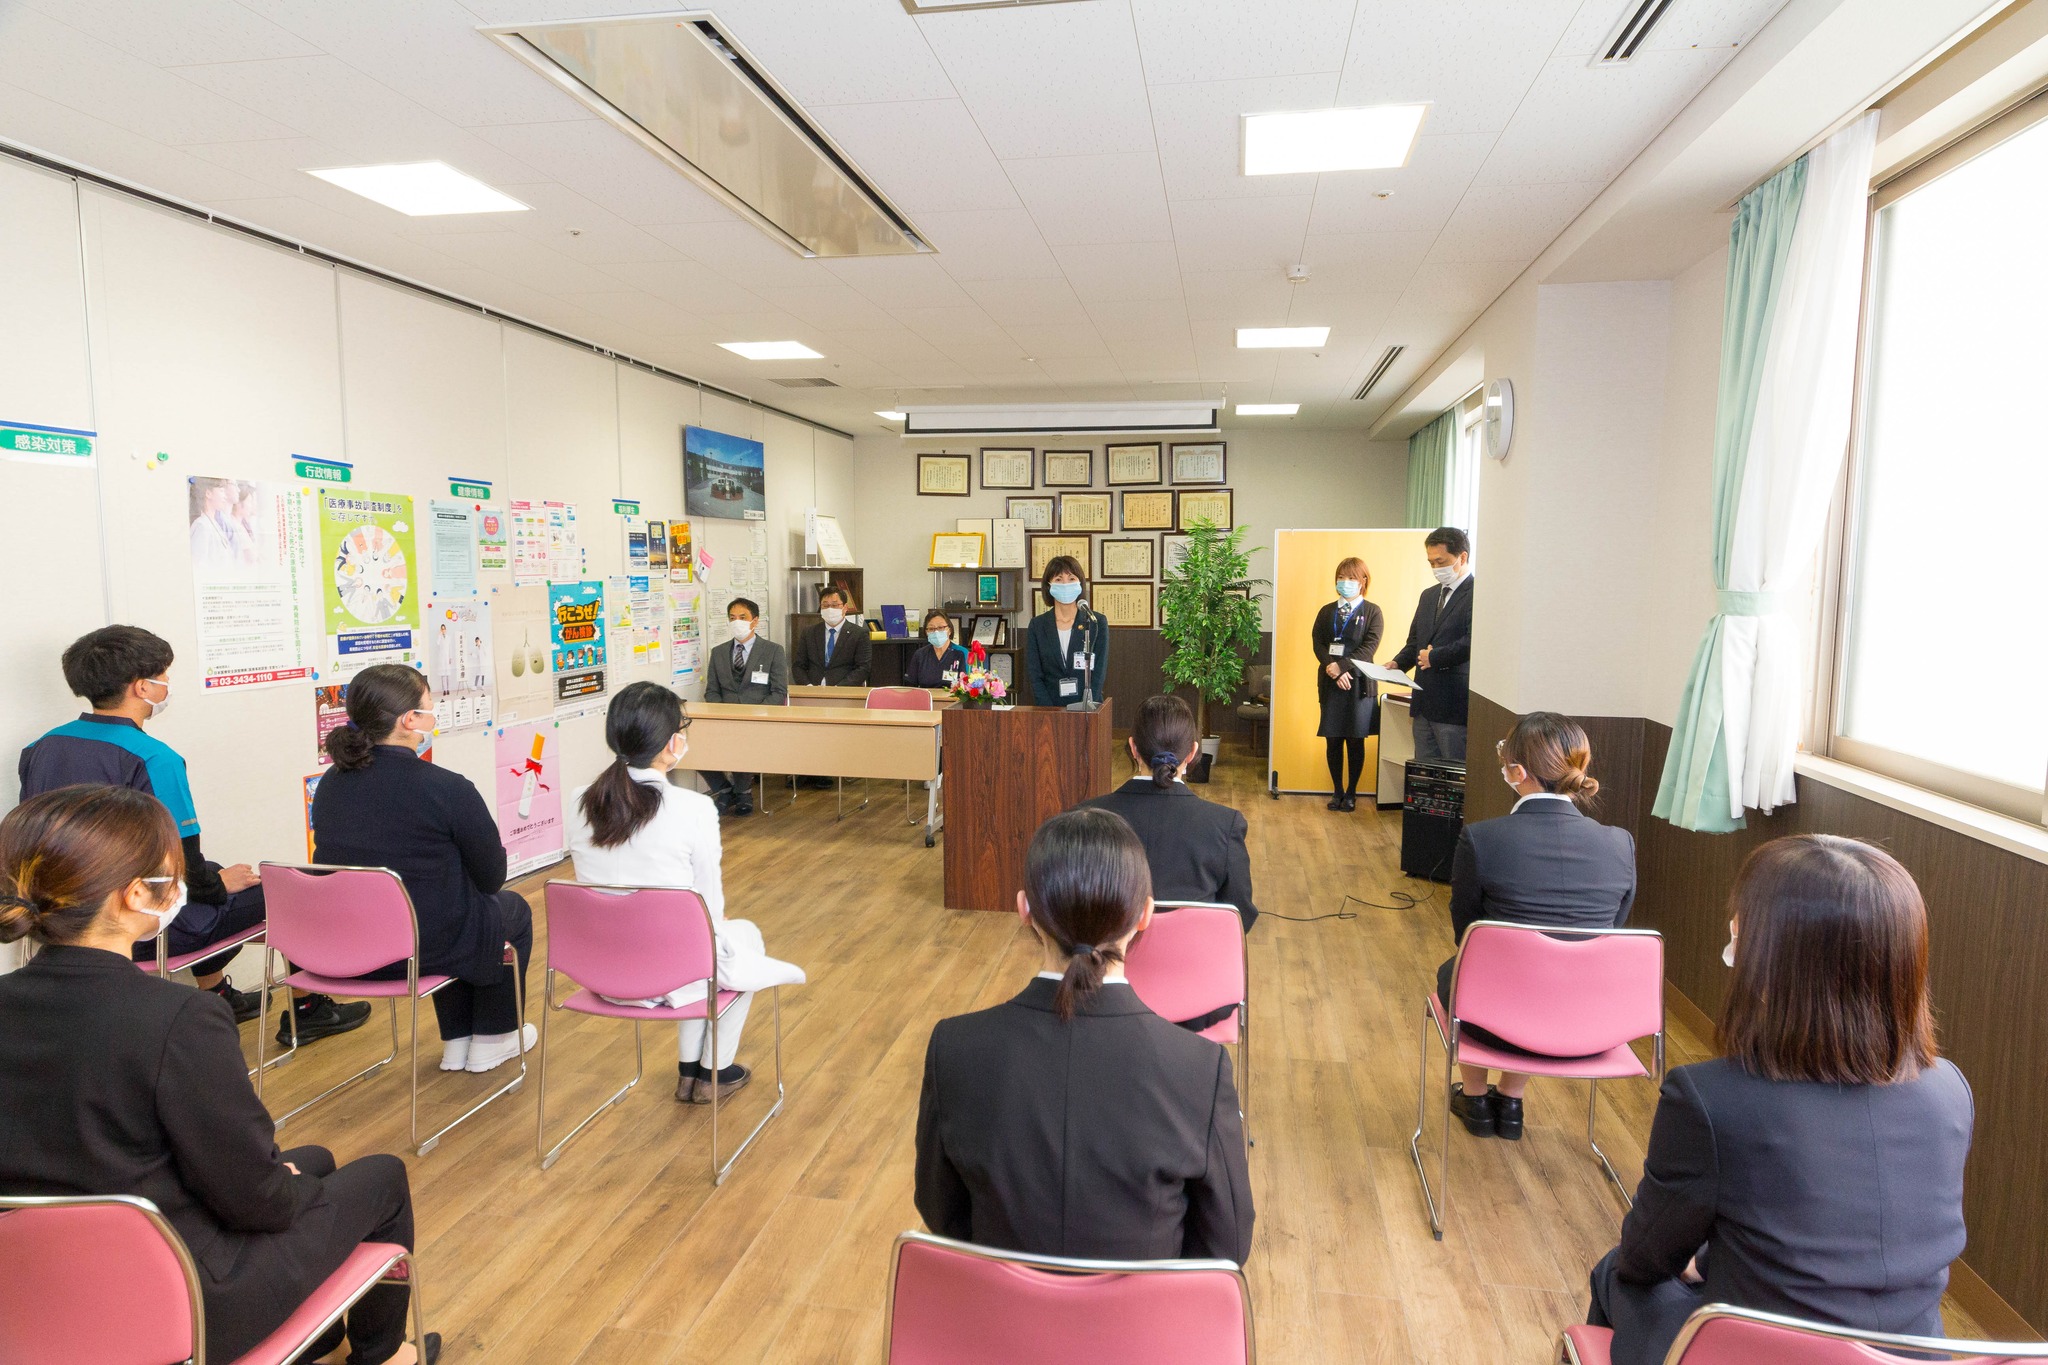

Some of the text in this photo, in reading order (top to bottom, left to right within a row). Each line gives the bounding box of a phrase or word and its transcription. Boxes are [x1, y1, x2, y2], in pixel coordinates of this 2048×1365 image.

[14, 434, 77, 454] 感染対策
[305, 465, 342, 481] 行政情報
[457, 486, 485, 499] 健康情報
[557, 601, 600, 623] 行こうぜ!
[565, 626, 593, 640] がん検診
[220, 673, 272, 685] 03-3434-1110
